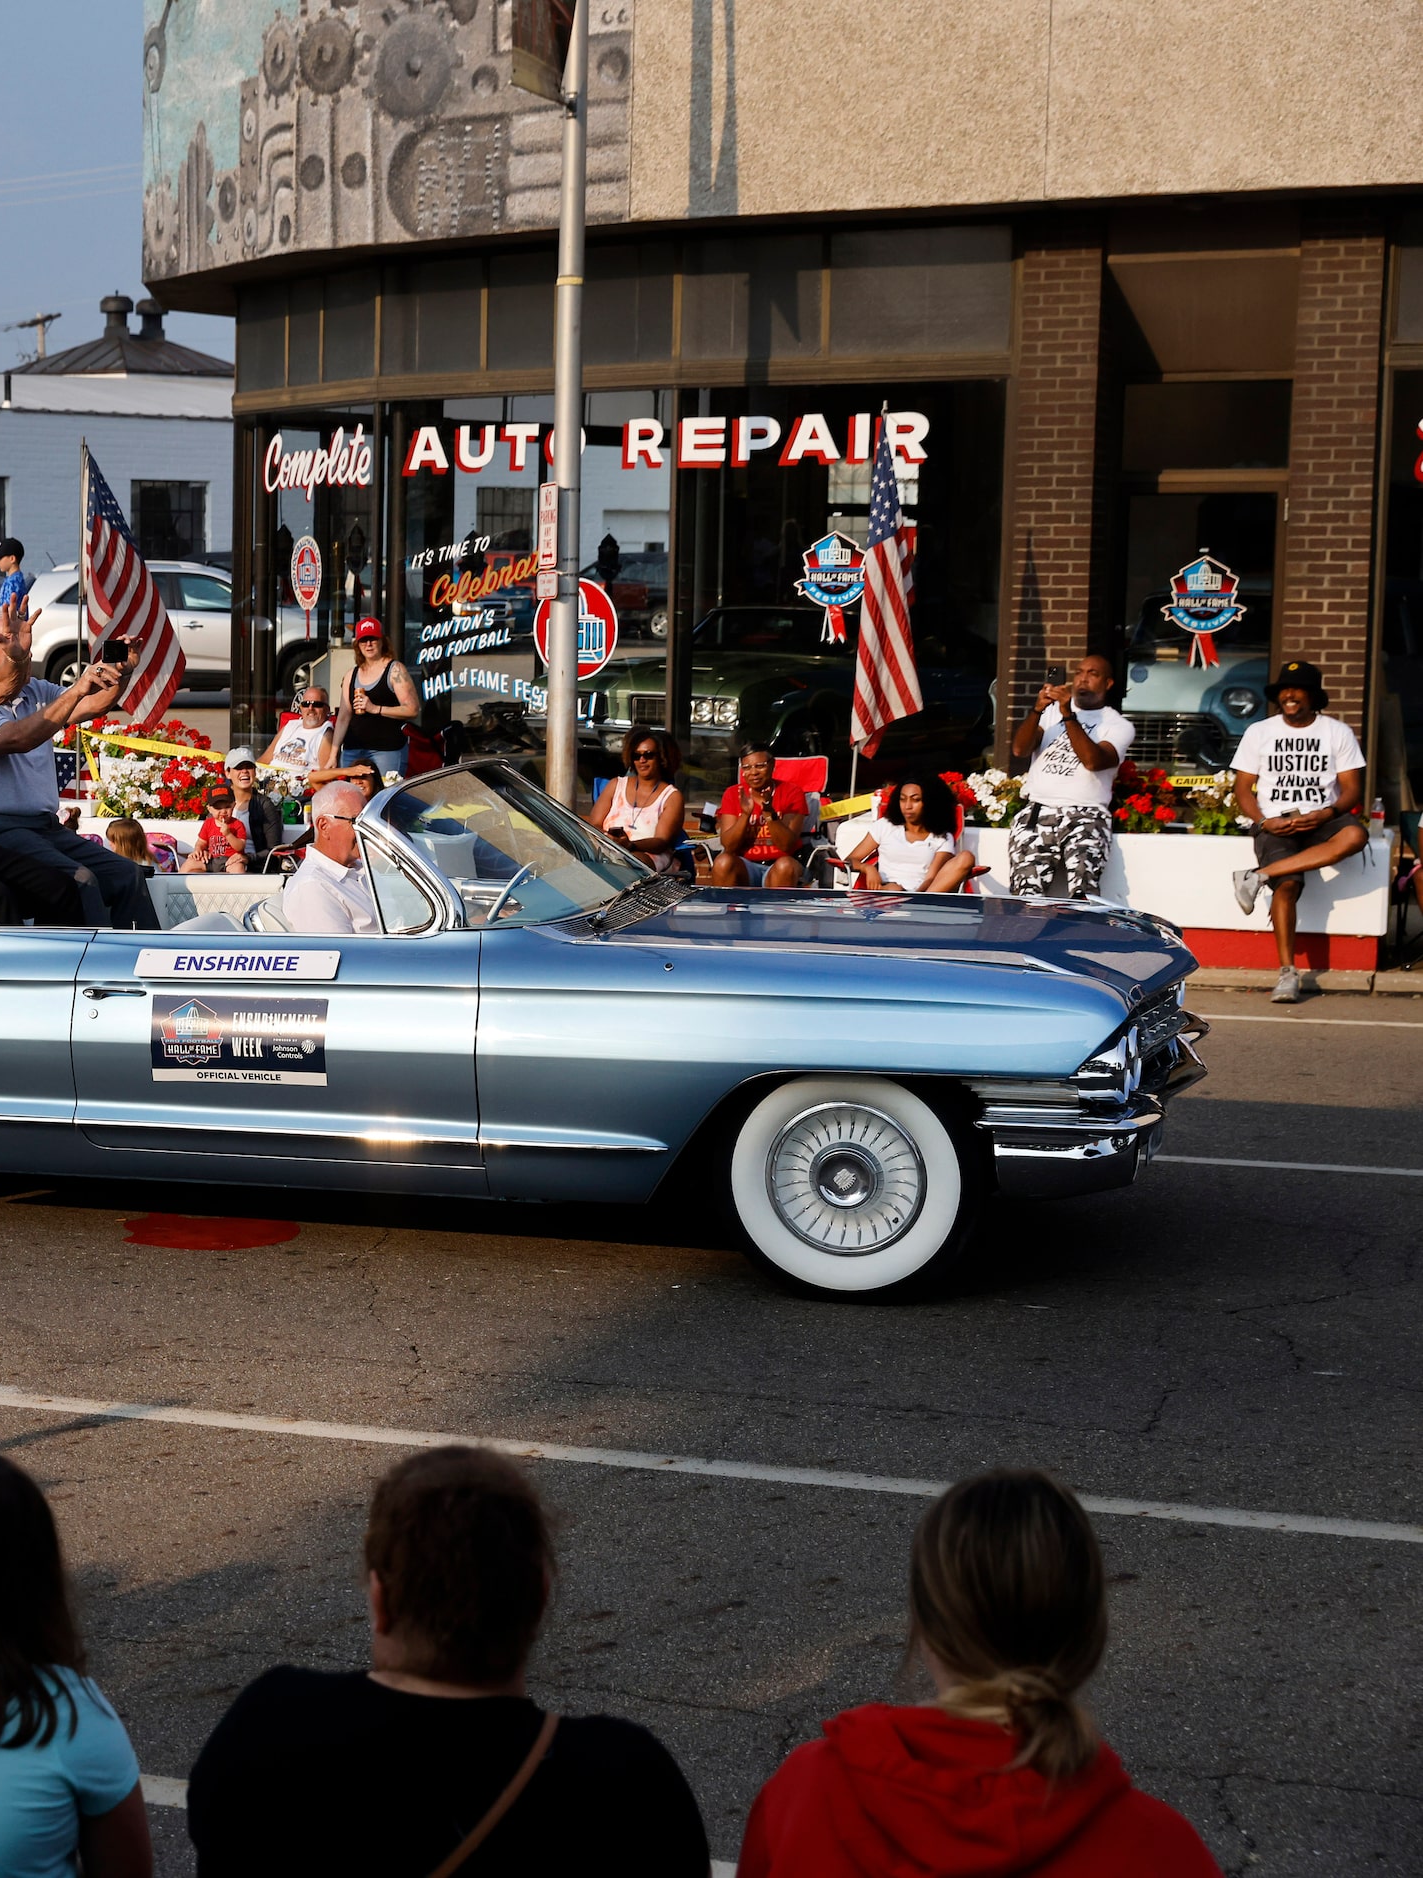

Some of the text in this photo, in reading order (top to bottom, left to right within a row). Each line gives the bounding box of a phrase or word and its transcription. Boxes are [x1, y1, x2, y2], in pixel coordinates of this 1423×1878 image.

[263, 423, 371, 502] Complete
[622, 412, 930, 469] REPAIR
[544, 491, 552, 506] NO
[540, 509, 556, 524] PARKING
[411, 536, 491, 570] IT'S TIME TO
[420, 609, 495, 643] CANTON'S
[416, 628, 512, 665] PRO FOOTBALL
[422, 671, 460, 700] HALL
[470, 669, 509, 693] FAME
[1275, 738, 1321, 752] KNOW
[1042, 763, 1077, 777] ISSUE
[1268, 755, 1329, 772] JUSTICE
[1176, 777, 1215, 786] CAUTIO
[1276, 775, 1320, 787] KNOW
[1270, 788, 1326, 804] PEACE
[174, 956, 300, 971] ENSHRINEE
[167, 1044, 190, 1055] HALL
[195, 1044, 218, 1055] FAME
[231, 1036, 263, 1057] WEEK
[272, 1044, 298, 1052] Johnson
[196, 1072, 282, 1081] OFFICIAL VEHICLE
